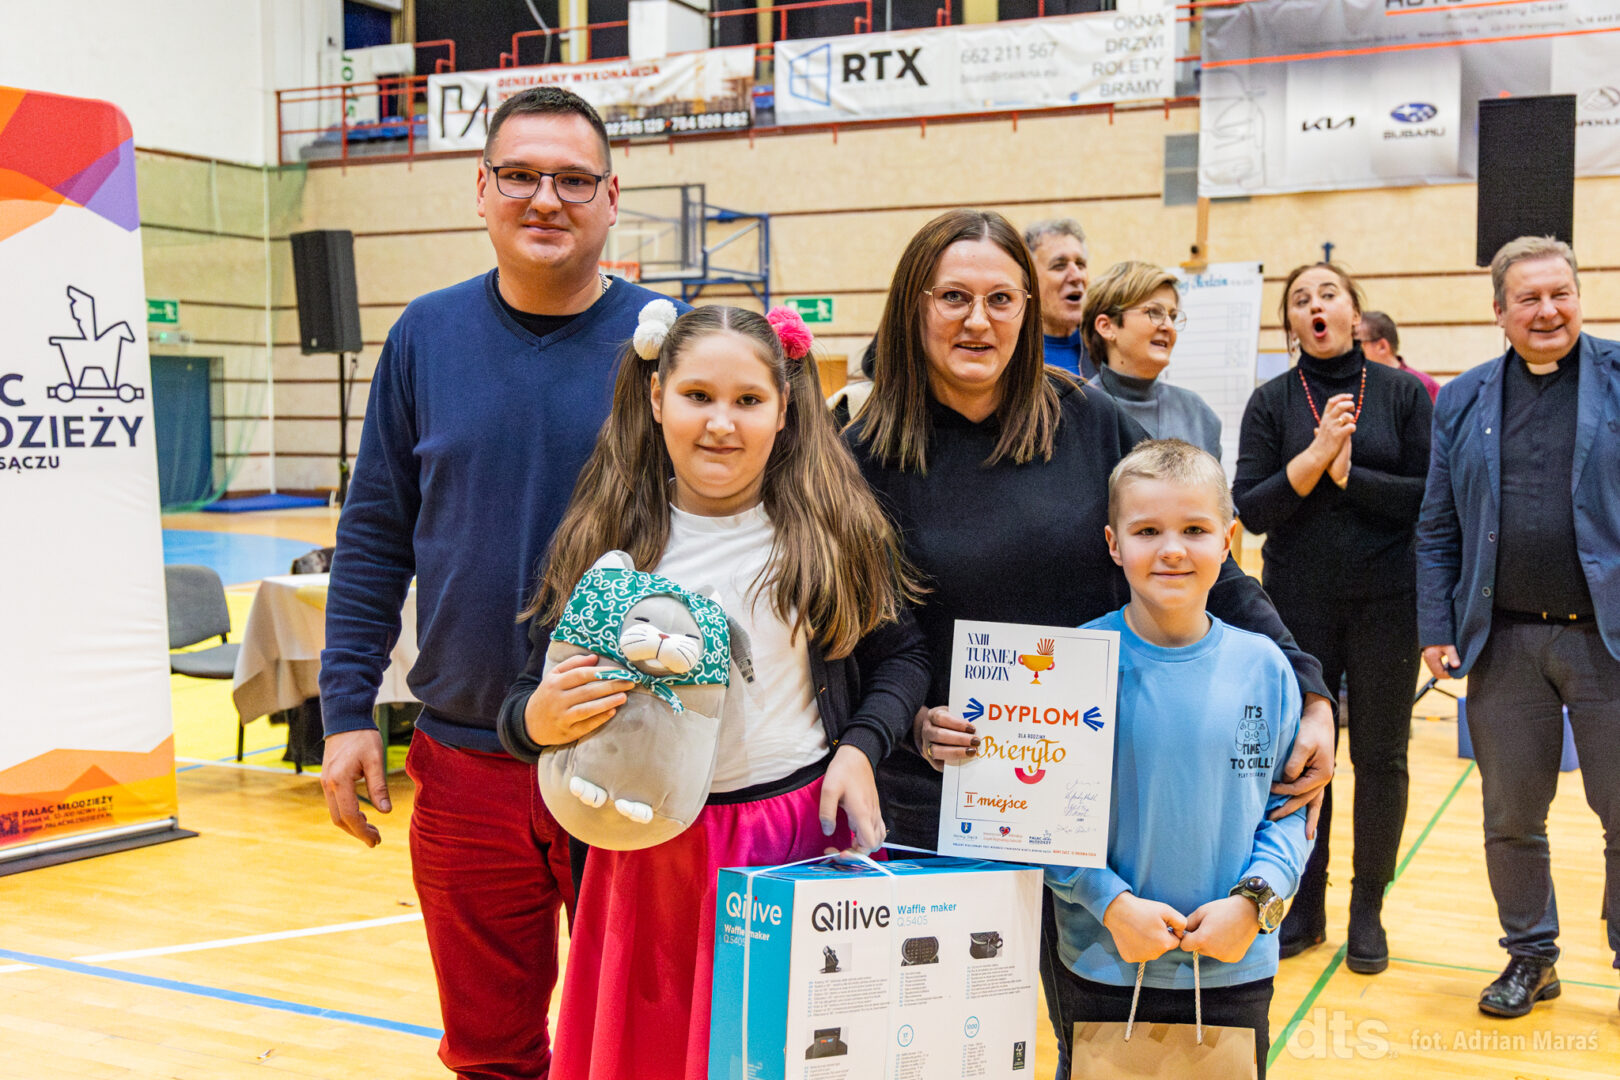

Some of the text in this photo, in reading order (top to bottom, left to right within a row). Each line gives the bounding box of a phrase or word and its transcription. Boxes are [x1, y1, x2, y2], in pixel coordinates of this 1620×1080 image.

[1114, 14, 1164, 31] OKNA
[1105, 35, 1164, 53] DRZWI
[961, 48, 989, 64] 662
[842, 48, 928, 86] RTX
[1092, 57, 1163, 77] ROLETY
[497, 73, 566, 87] GENERALNY
[1099, 79, 1163, 97] BRAMY
[1383, 128, 1446, 140] SUBARU
[968, 633, 990, 645] XXIII
[966, 648, 1017, 666] TURNIEJ
[964, 664, 1010, 681] RODZIN
[988, 703, 1079, 727] DYPLOM
[1244, 705, 1263, 719] IT'S
[1230, 758, 1245, 769] TO
[977, 794, 1028, 813] miejsce
[811, 900, 891, 932] Qilive
[896, 901, 957, 915] Waffle maker
